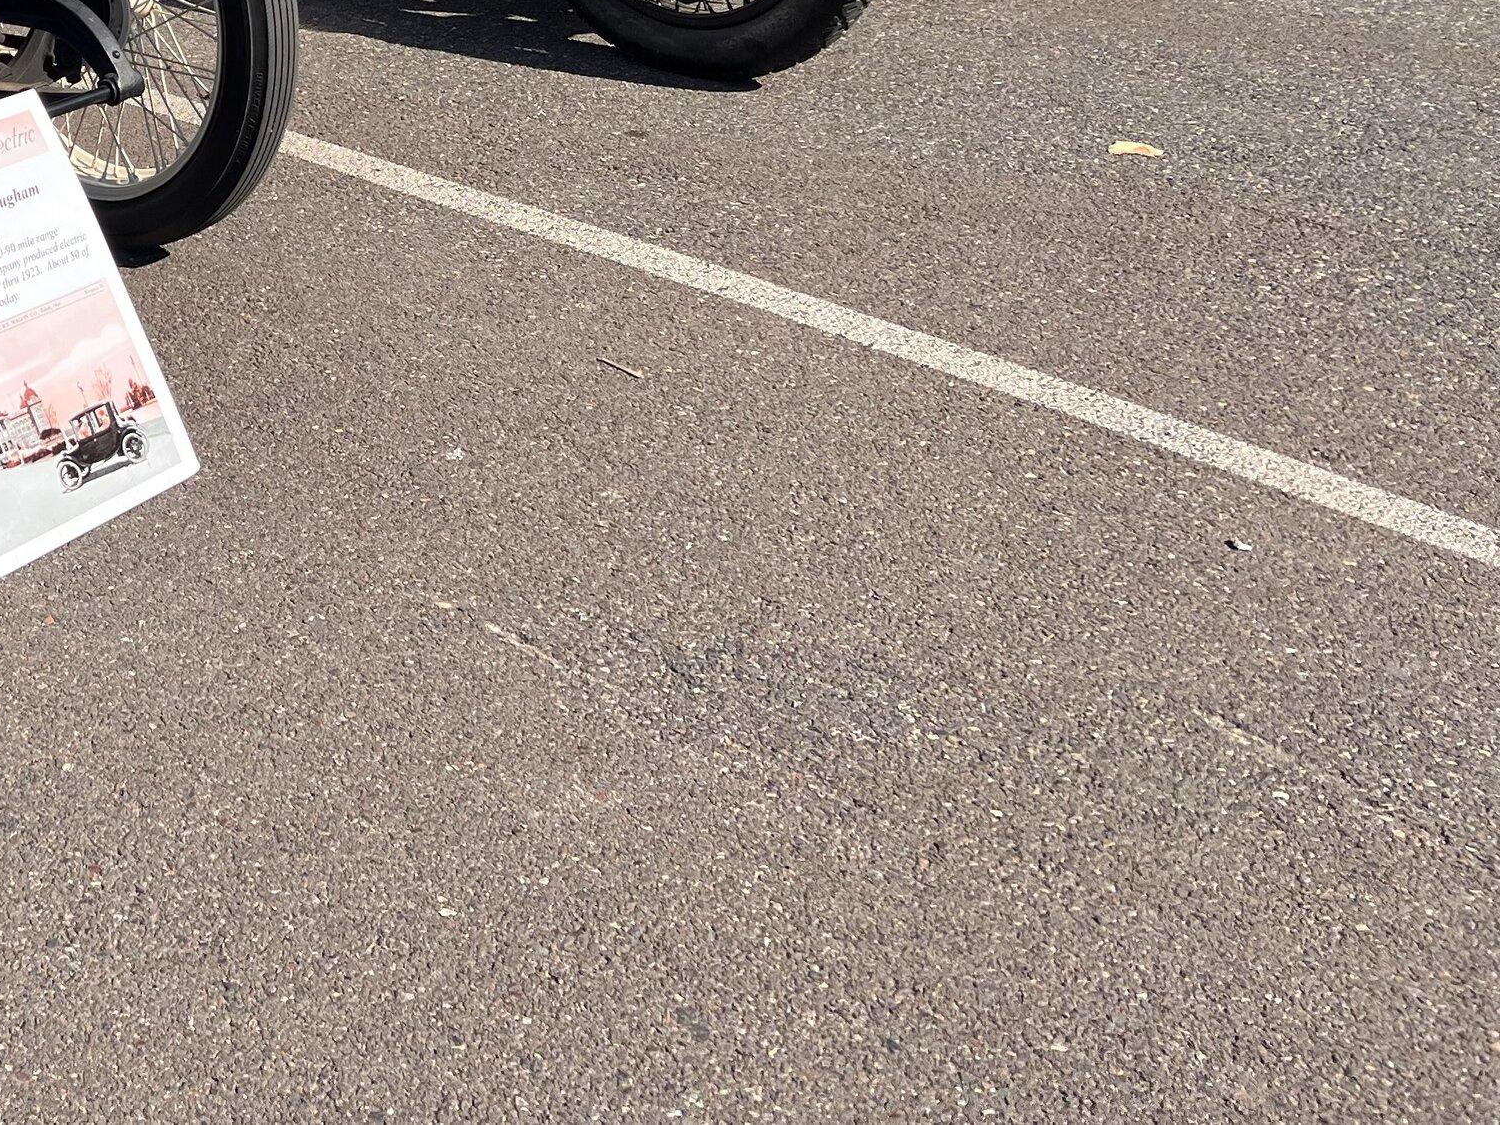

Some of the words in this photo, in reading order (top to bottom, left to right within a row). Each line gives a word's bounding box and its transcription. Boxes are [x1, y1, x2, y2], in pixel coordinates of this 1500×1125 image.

[18, 236, 35, 251] mile
[23, 242, 58, 268] produced
[59, 233, 87, 250] electric
[2, 276, 20, 290] thru
[21, 265, 42, 282] 1923.
[47, 258, 69, 272] About
[81, 244, 90, 258] of
